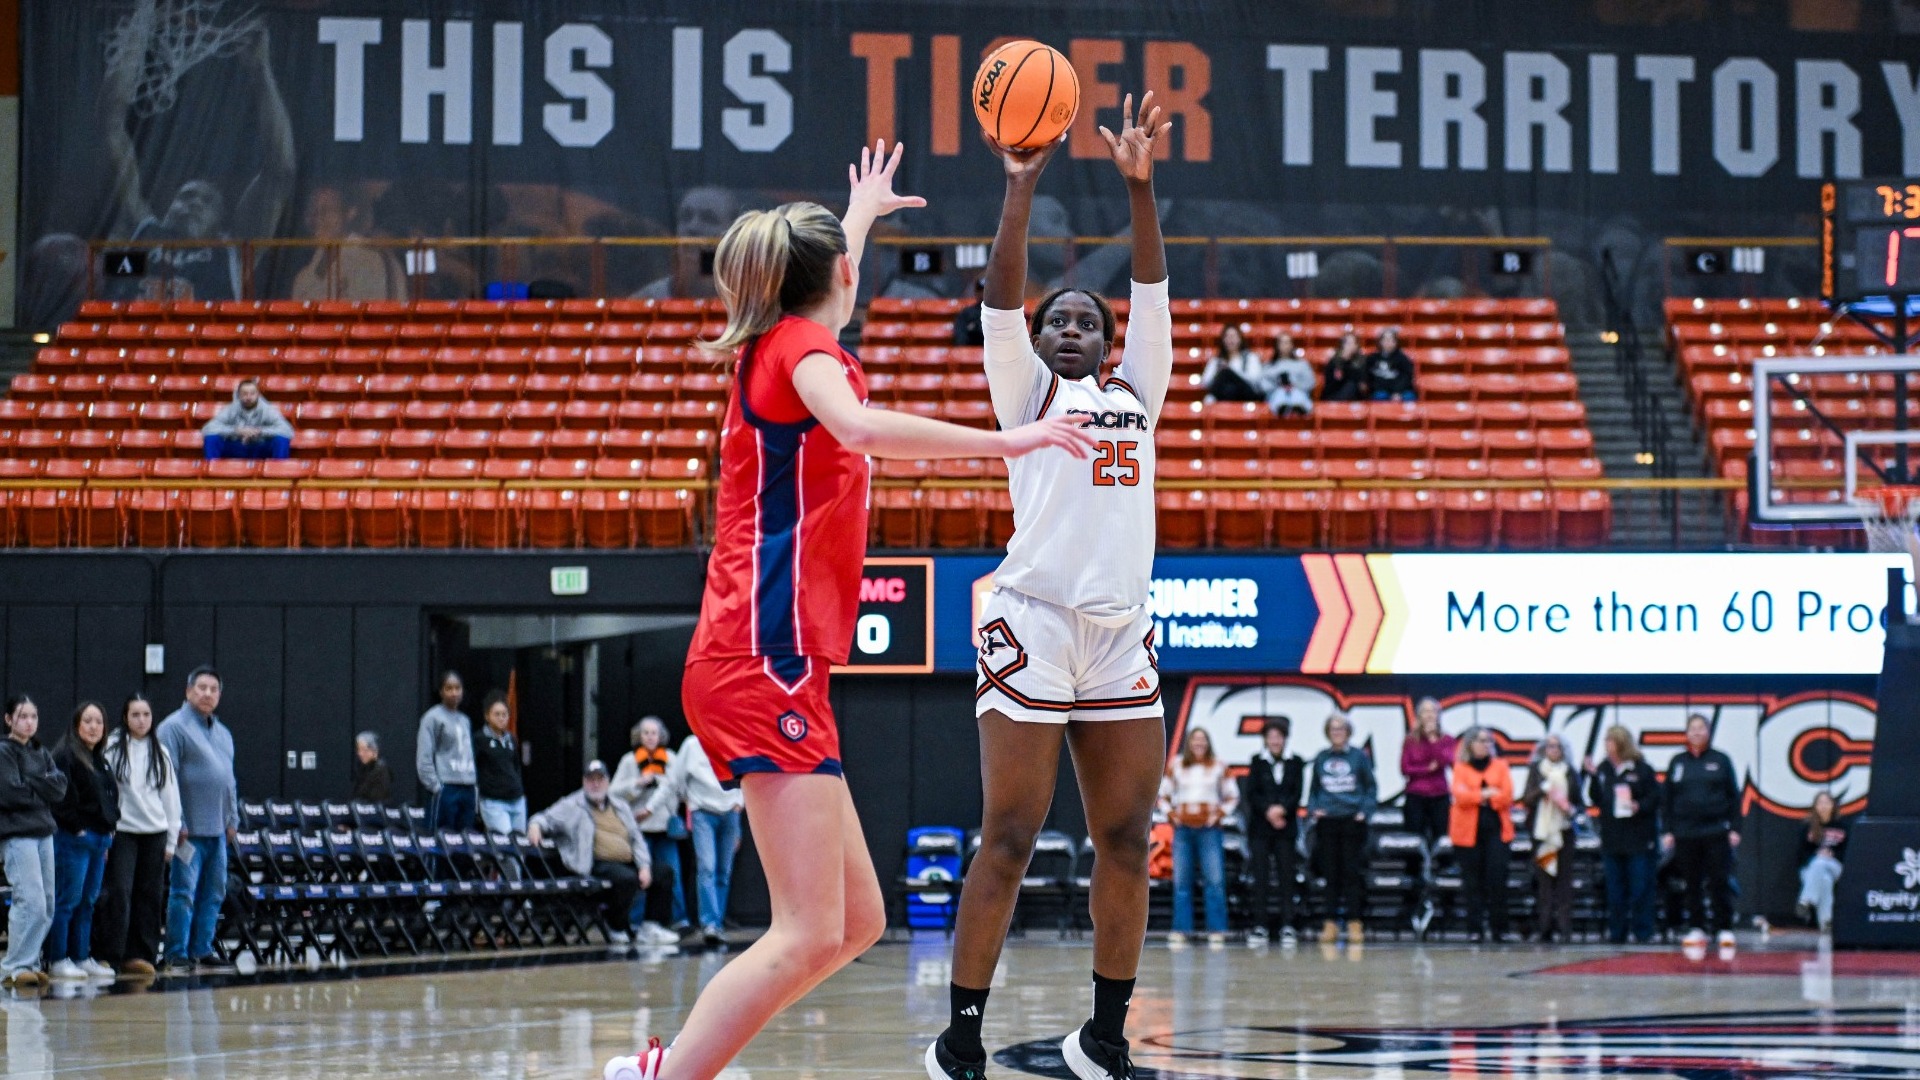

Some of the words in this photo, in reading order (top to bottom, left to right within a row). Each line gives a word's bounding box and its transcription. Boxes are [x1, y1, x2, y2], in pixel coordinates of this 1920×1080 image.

[318, 17, 615, 148] THIS
[671, 26, 794, 152] IS
[850, 31, 1212, 163] TIER
[979, 60, 1007, 112] NCAA
[116, 256, 133, 273] A
[1066, 409, 1148, 433] ACIFIC
[1092, 440, 1140, 487] 25
[1447, 590, 1571, 633] More
[1593, 590, 1698, 633] than
[1722, 590, 1774, 633] 60
[857, 614, 890, 655] 0
[1168, 620, 1259, 648] Institute
[1867, 890, 1919, 911] Dignity
